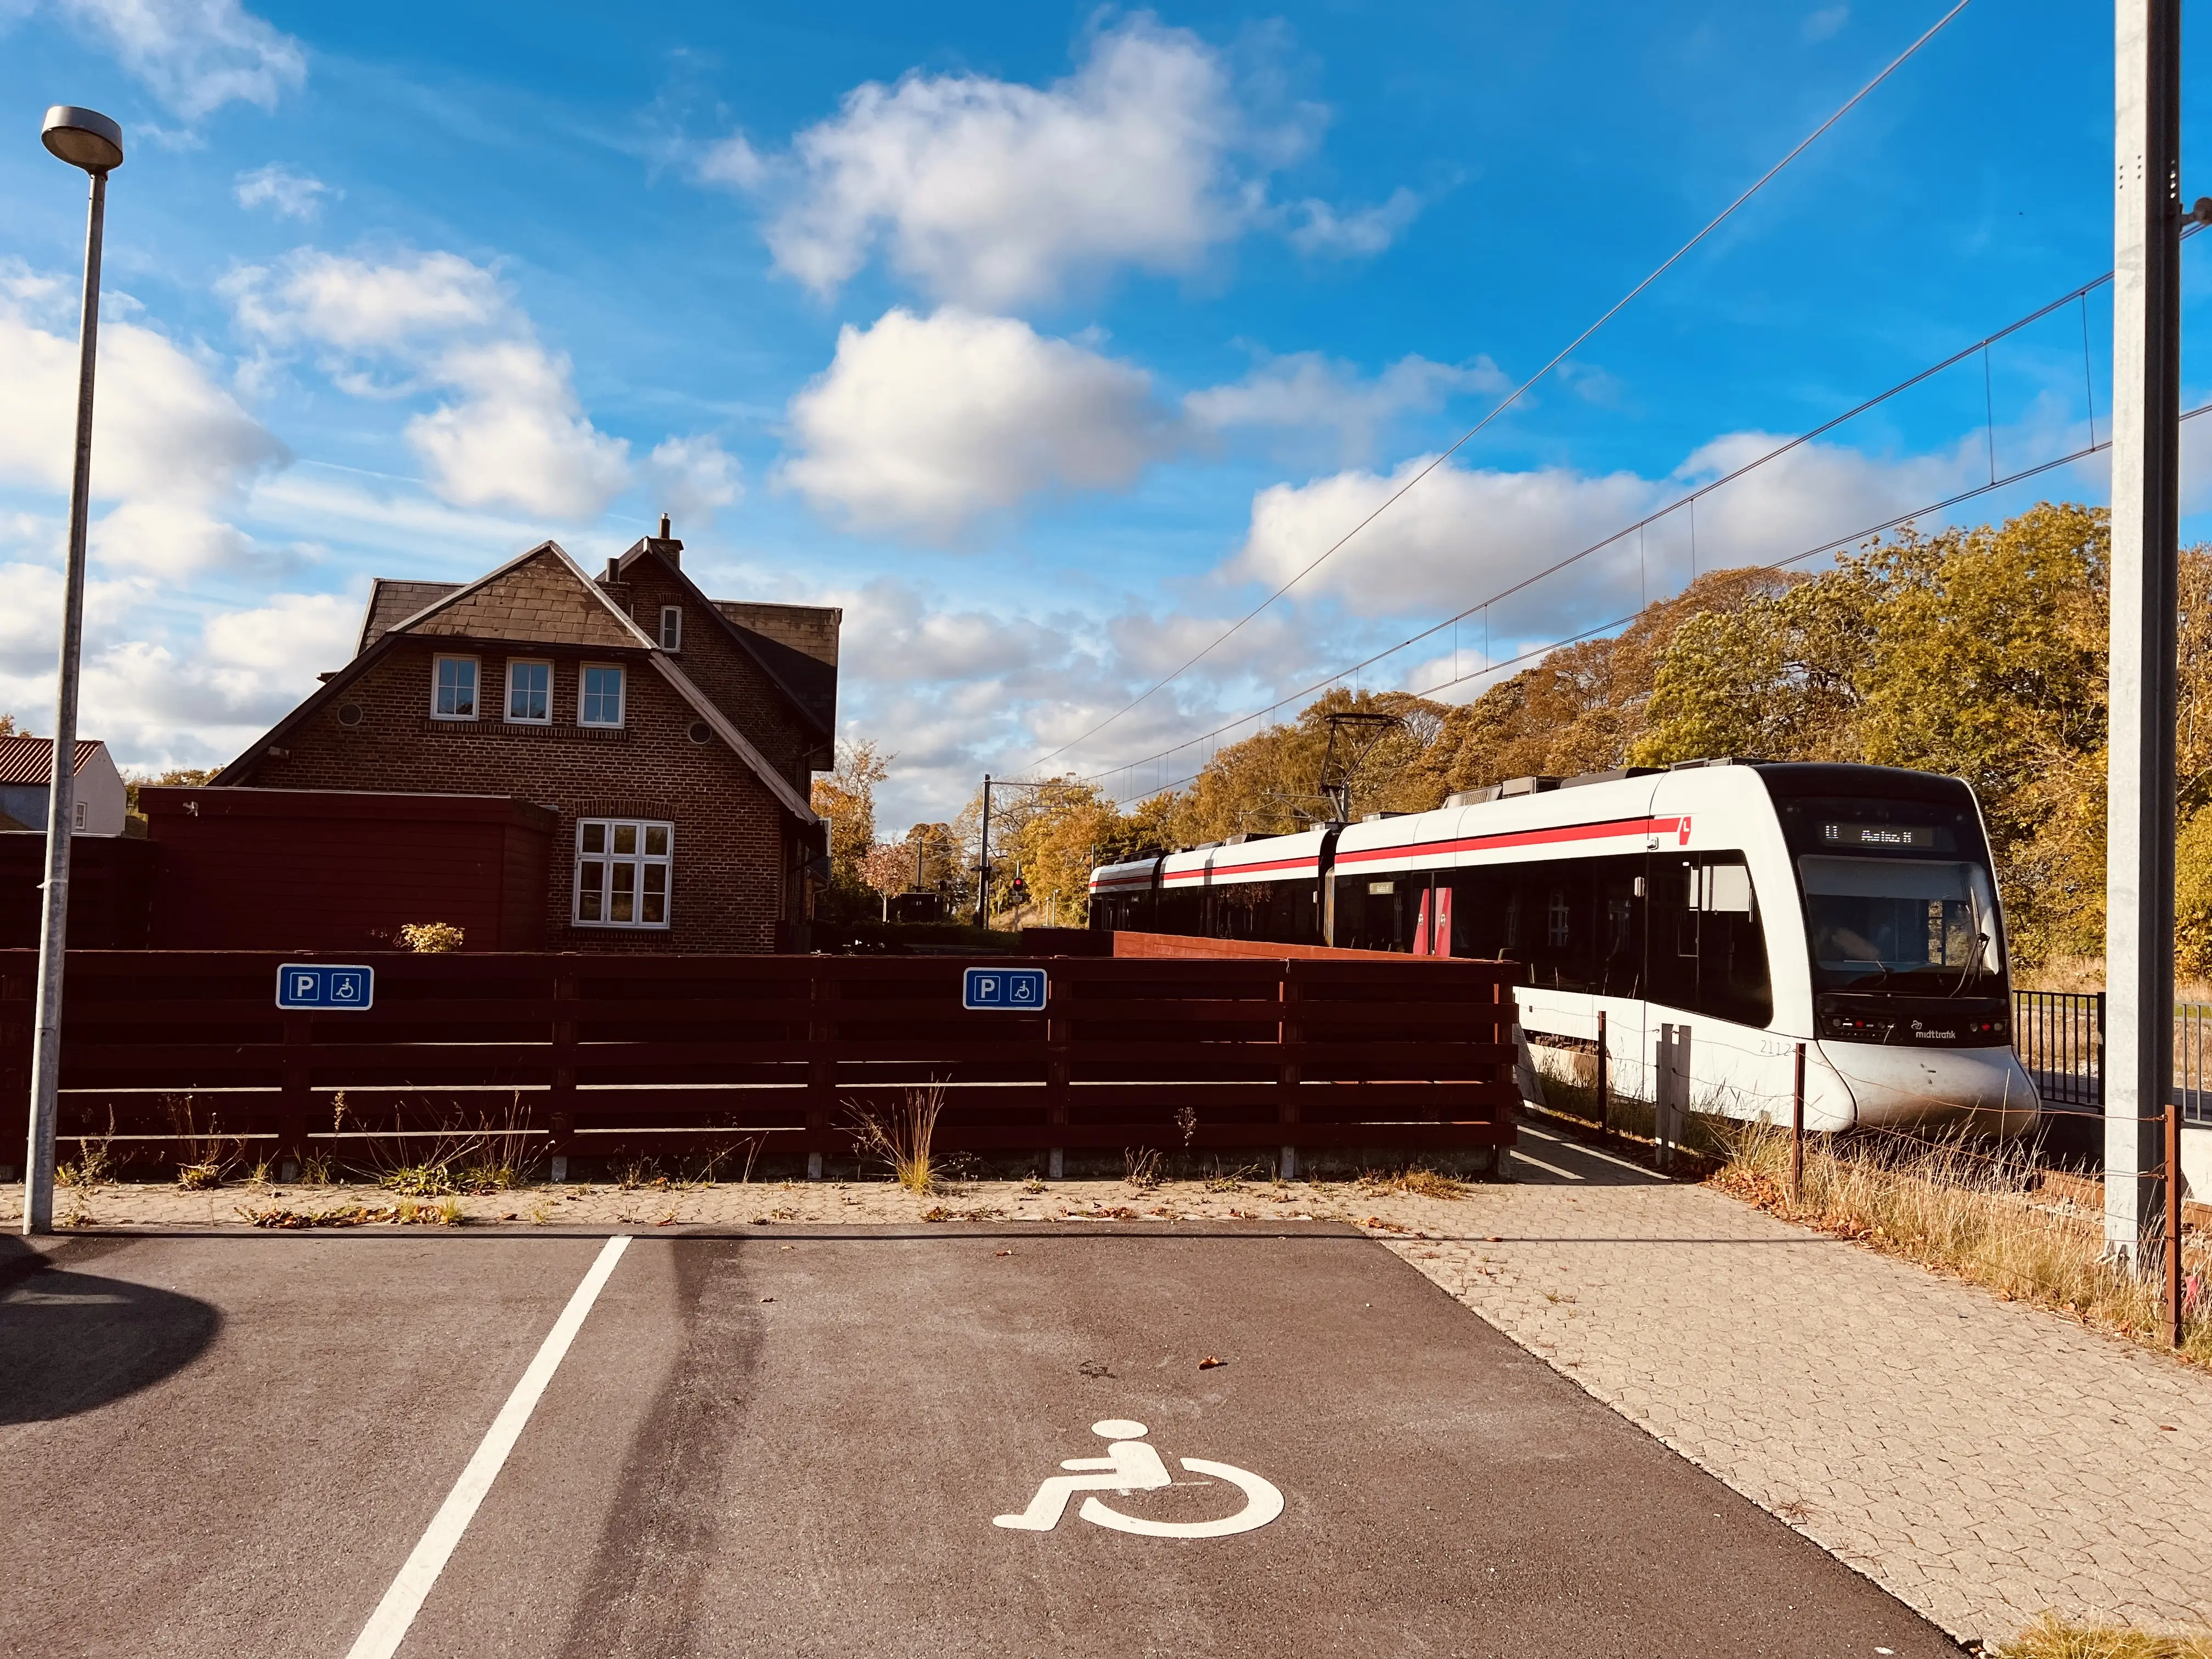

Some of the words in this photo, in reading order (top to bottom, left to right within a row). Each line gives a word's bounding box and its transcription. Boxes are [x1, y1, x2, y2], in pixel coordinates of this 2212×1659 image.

[297, 976, 314, 997] P
[981, 979, 995, 998] P
[1916, 1030, 1956, 1039] midttrafik
[1760, 1040, 1791, 1057] 2112
